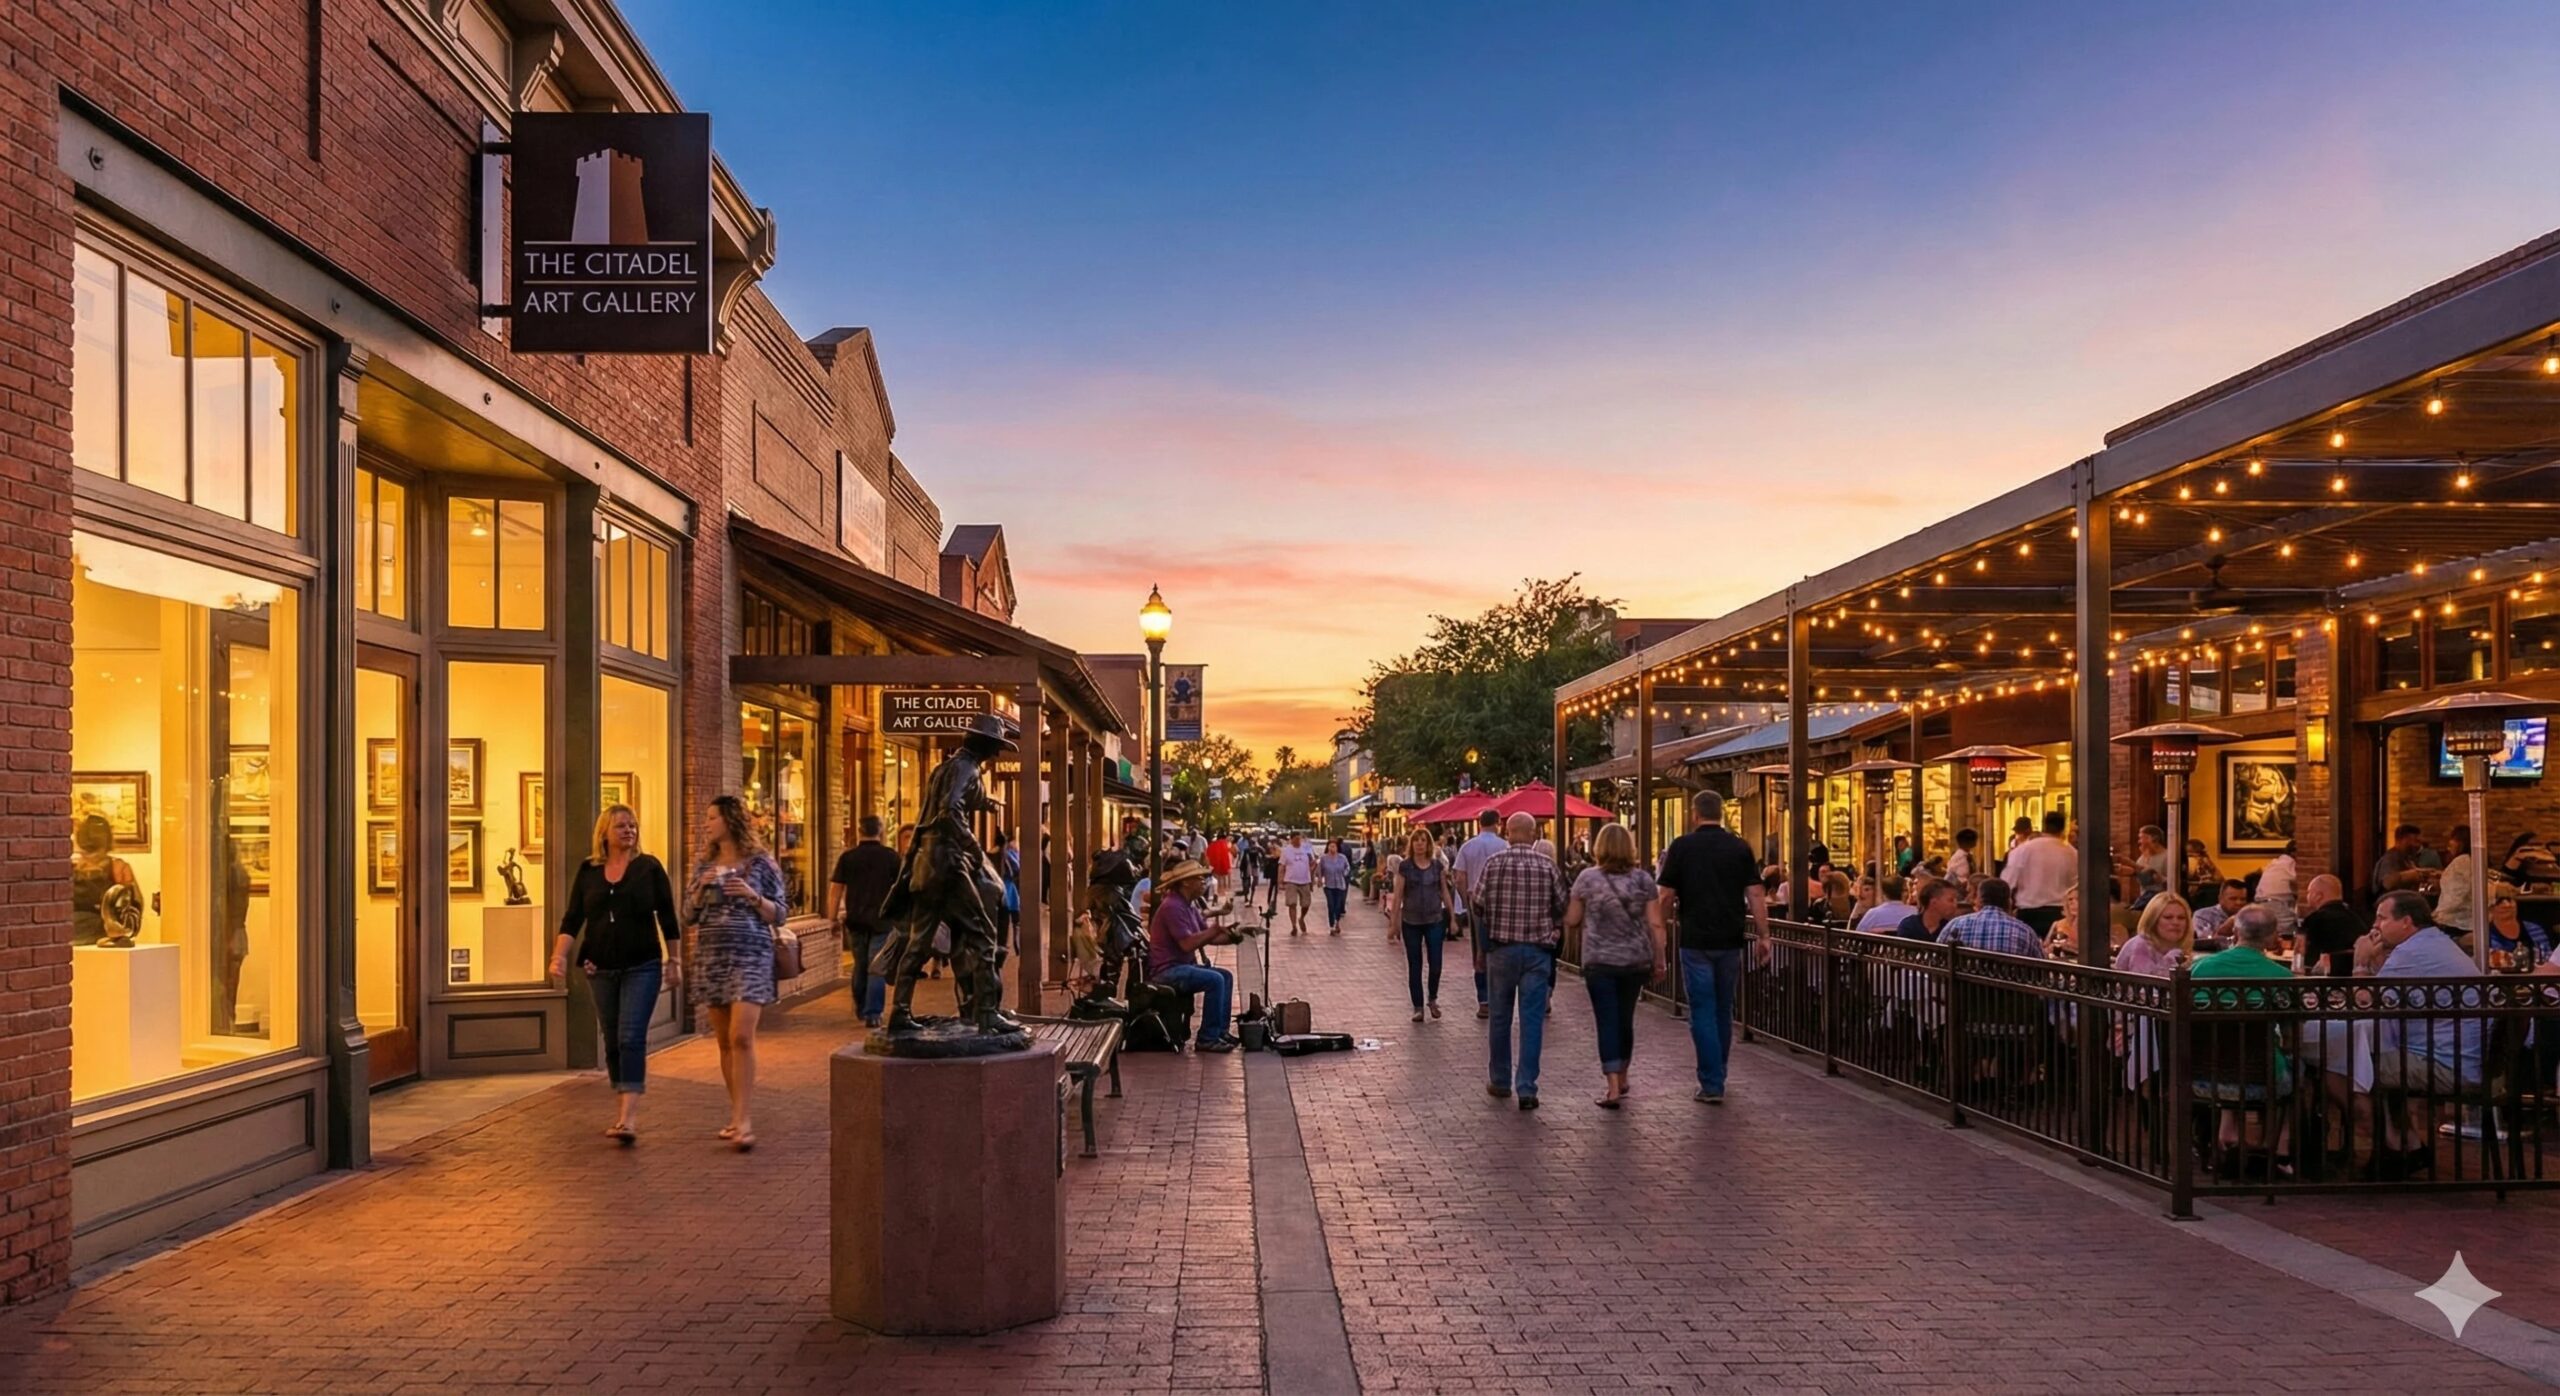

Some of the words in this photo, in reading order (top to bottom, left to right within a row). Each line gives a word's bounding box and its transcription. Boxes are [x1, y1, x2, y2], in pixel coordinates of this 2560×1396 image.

[524, 252, 575, 275] THE
[585, 252, 698, 275] CITADEL
[523, 291, 575, 313] ART
[582, 291, 696, 314] GALLERY
[893, 697, 920, 709] THE
[924, 697, 981, 709] CITADEL
[893, 716, 920, 728] ART
[923, 716, 974, 729] GALLER
